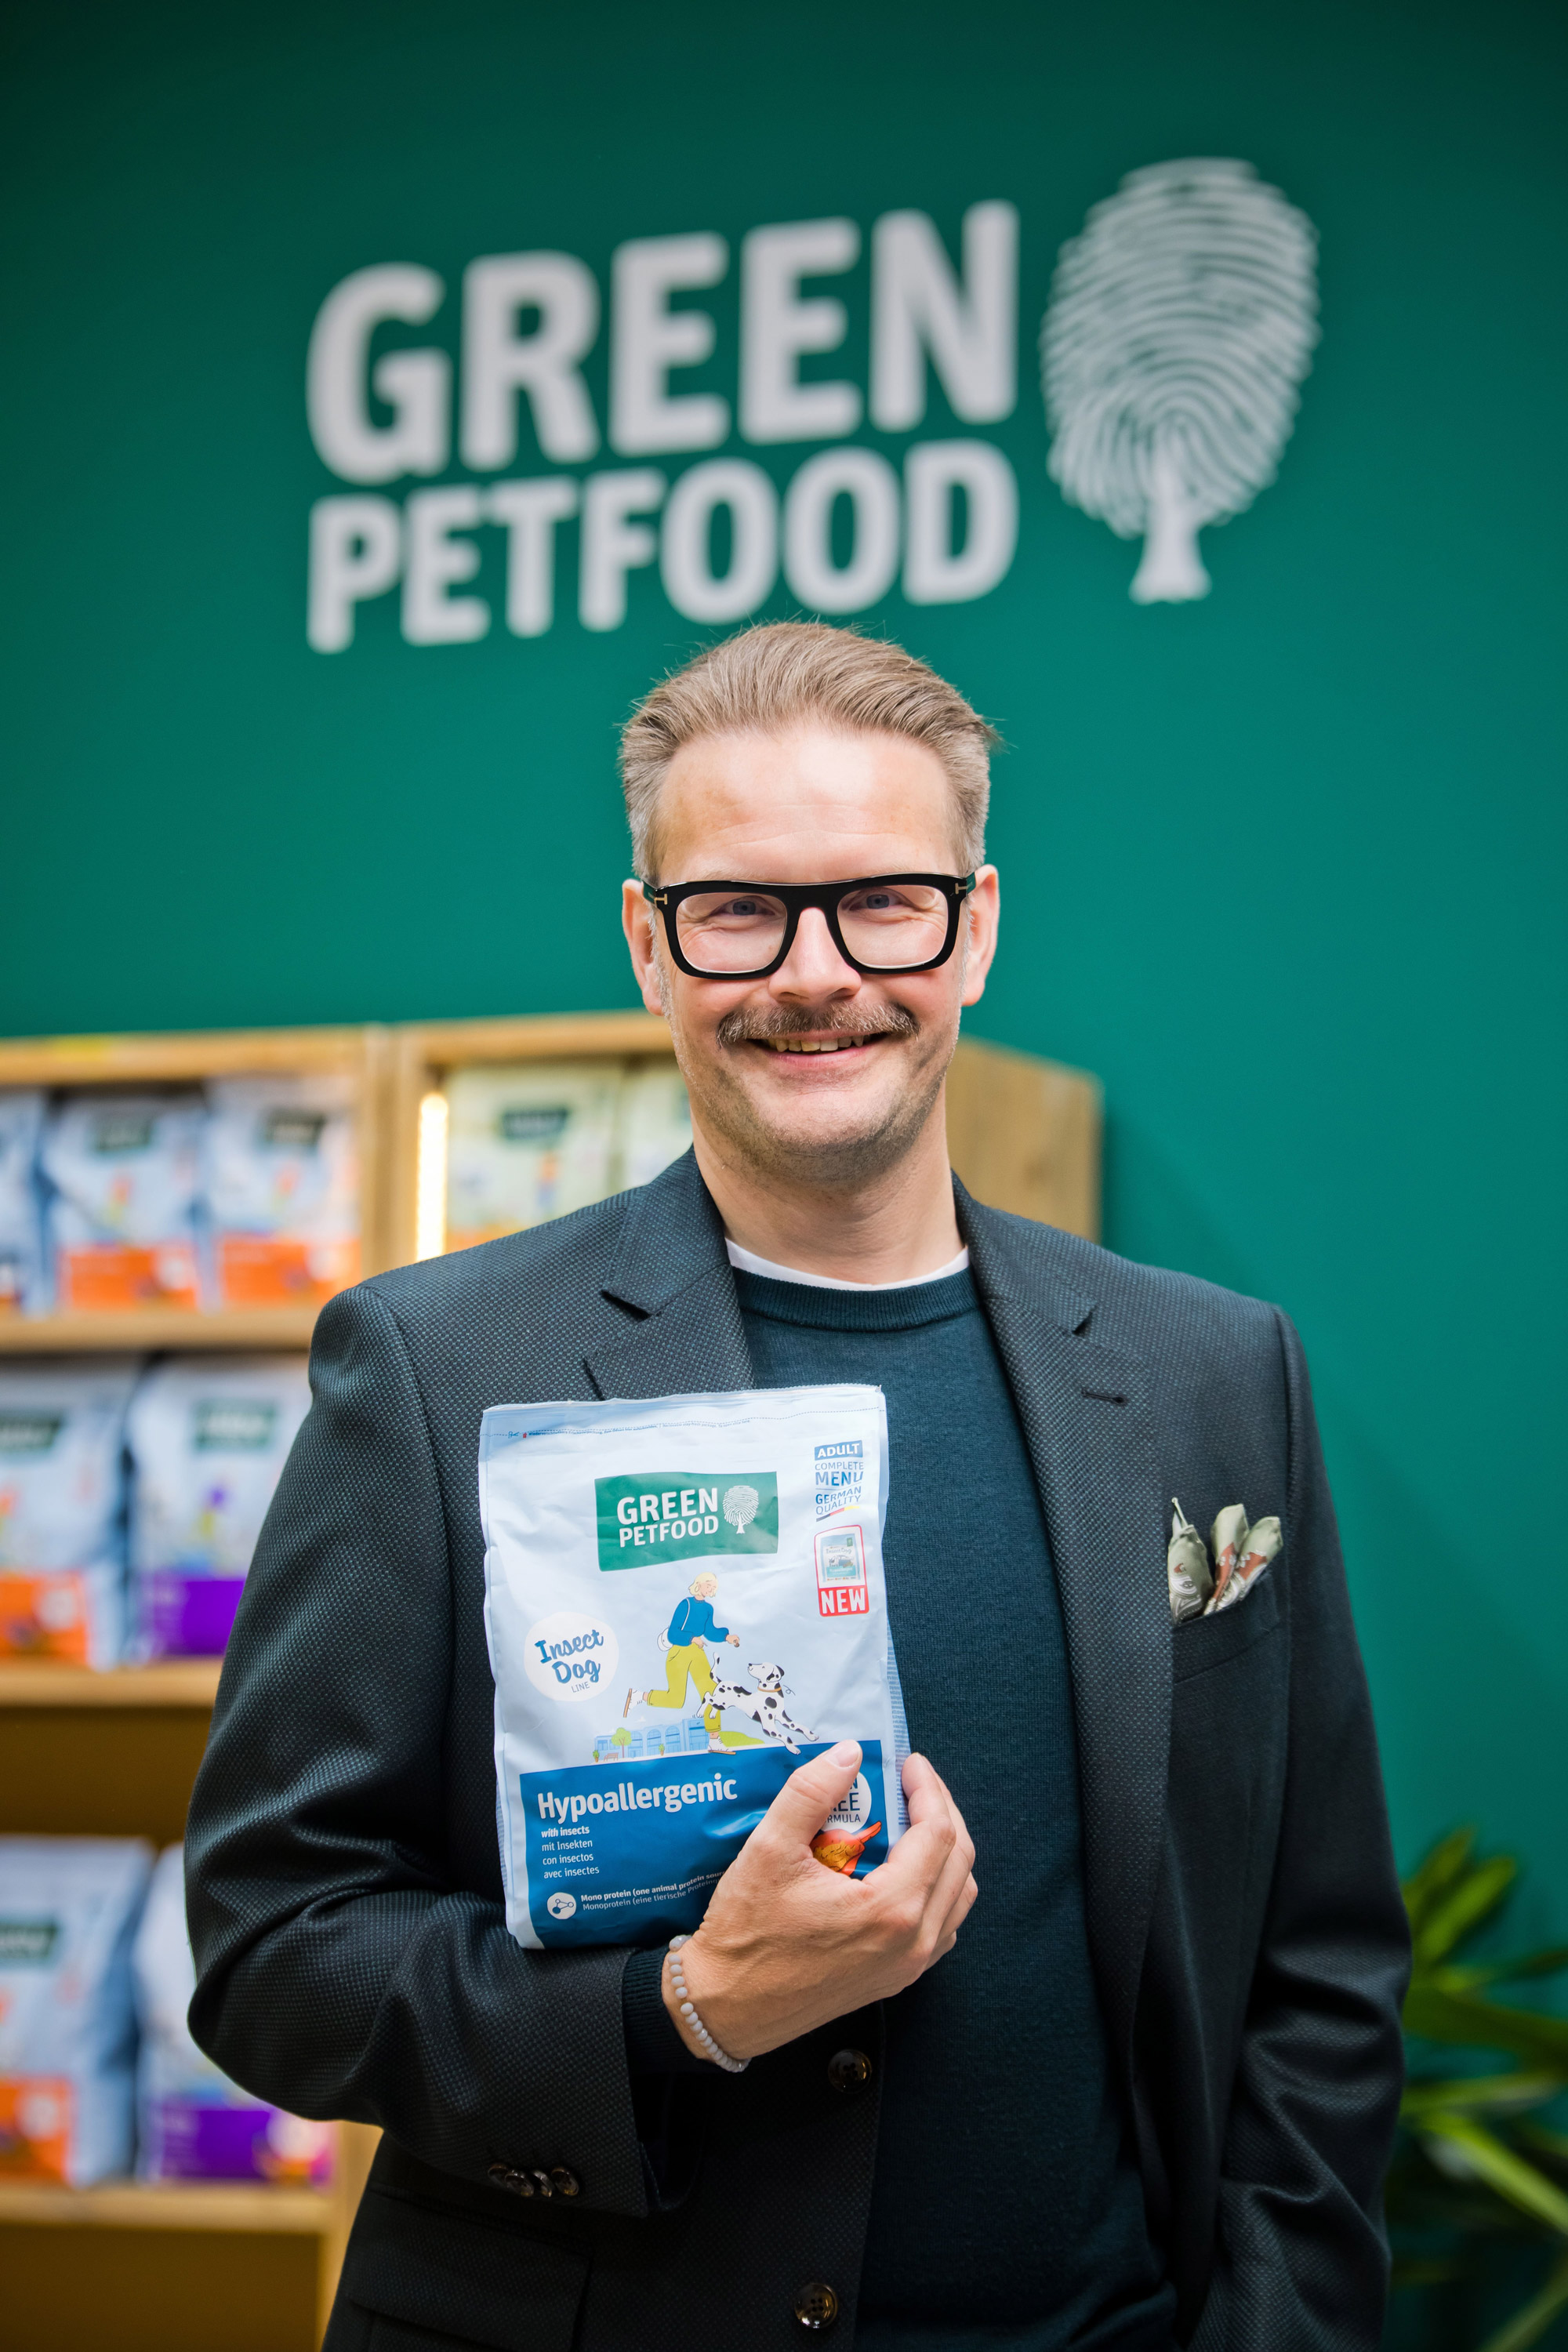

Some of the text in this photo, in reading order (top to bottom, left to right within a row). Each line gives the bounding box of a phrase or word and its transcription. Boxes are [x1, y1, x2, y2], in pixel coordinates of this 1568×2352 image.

[305, 199, 1019, 485] GREEN
[307, 439, 1019, 655] PETFOOD
[818, 1443, 859, 1458] ADULT
[815, 1461, 864, 1470] COMPLETE
[815, 1472, 863, 1486] MENU
[815, 1486, 861, 1504] GERMAN
[816, 1495, 861, 1515] QUALITY
[617, 1487, 717, 1525] GREEN
[619, 1515, 719, 1548] PETFOOD
[821, 1588, 865, 1614] NEW
[535, 1629, 604, 1664] Insect
[552, 1660, 601, 1684] Dog
[571, 1682, 590, 1693] LINE
[538, 1773, 738, 1824] Hypoallergenic
[541, 1825, 590, 1838] with insects
[542, 1839, 593, 1851] mit Insekten
[543, 1853, 593, 1865] con insectos
[543, 1866, 599, 1878] avec insectes
[604, 1889, 631, 1901] protein
[633, 1888, 650, 1897] (one
[652, 1883, 677, 1893] animal
[679, 1875, 705, 1891] protein
[583, 1899, 631, 1911] Monoprotein
[633, 1896, 652, 1906] (eine
[654, 1890, 686, 1901] tierische
